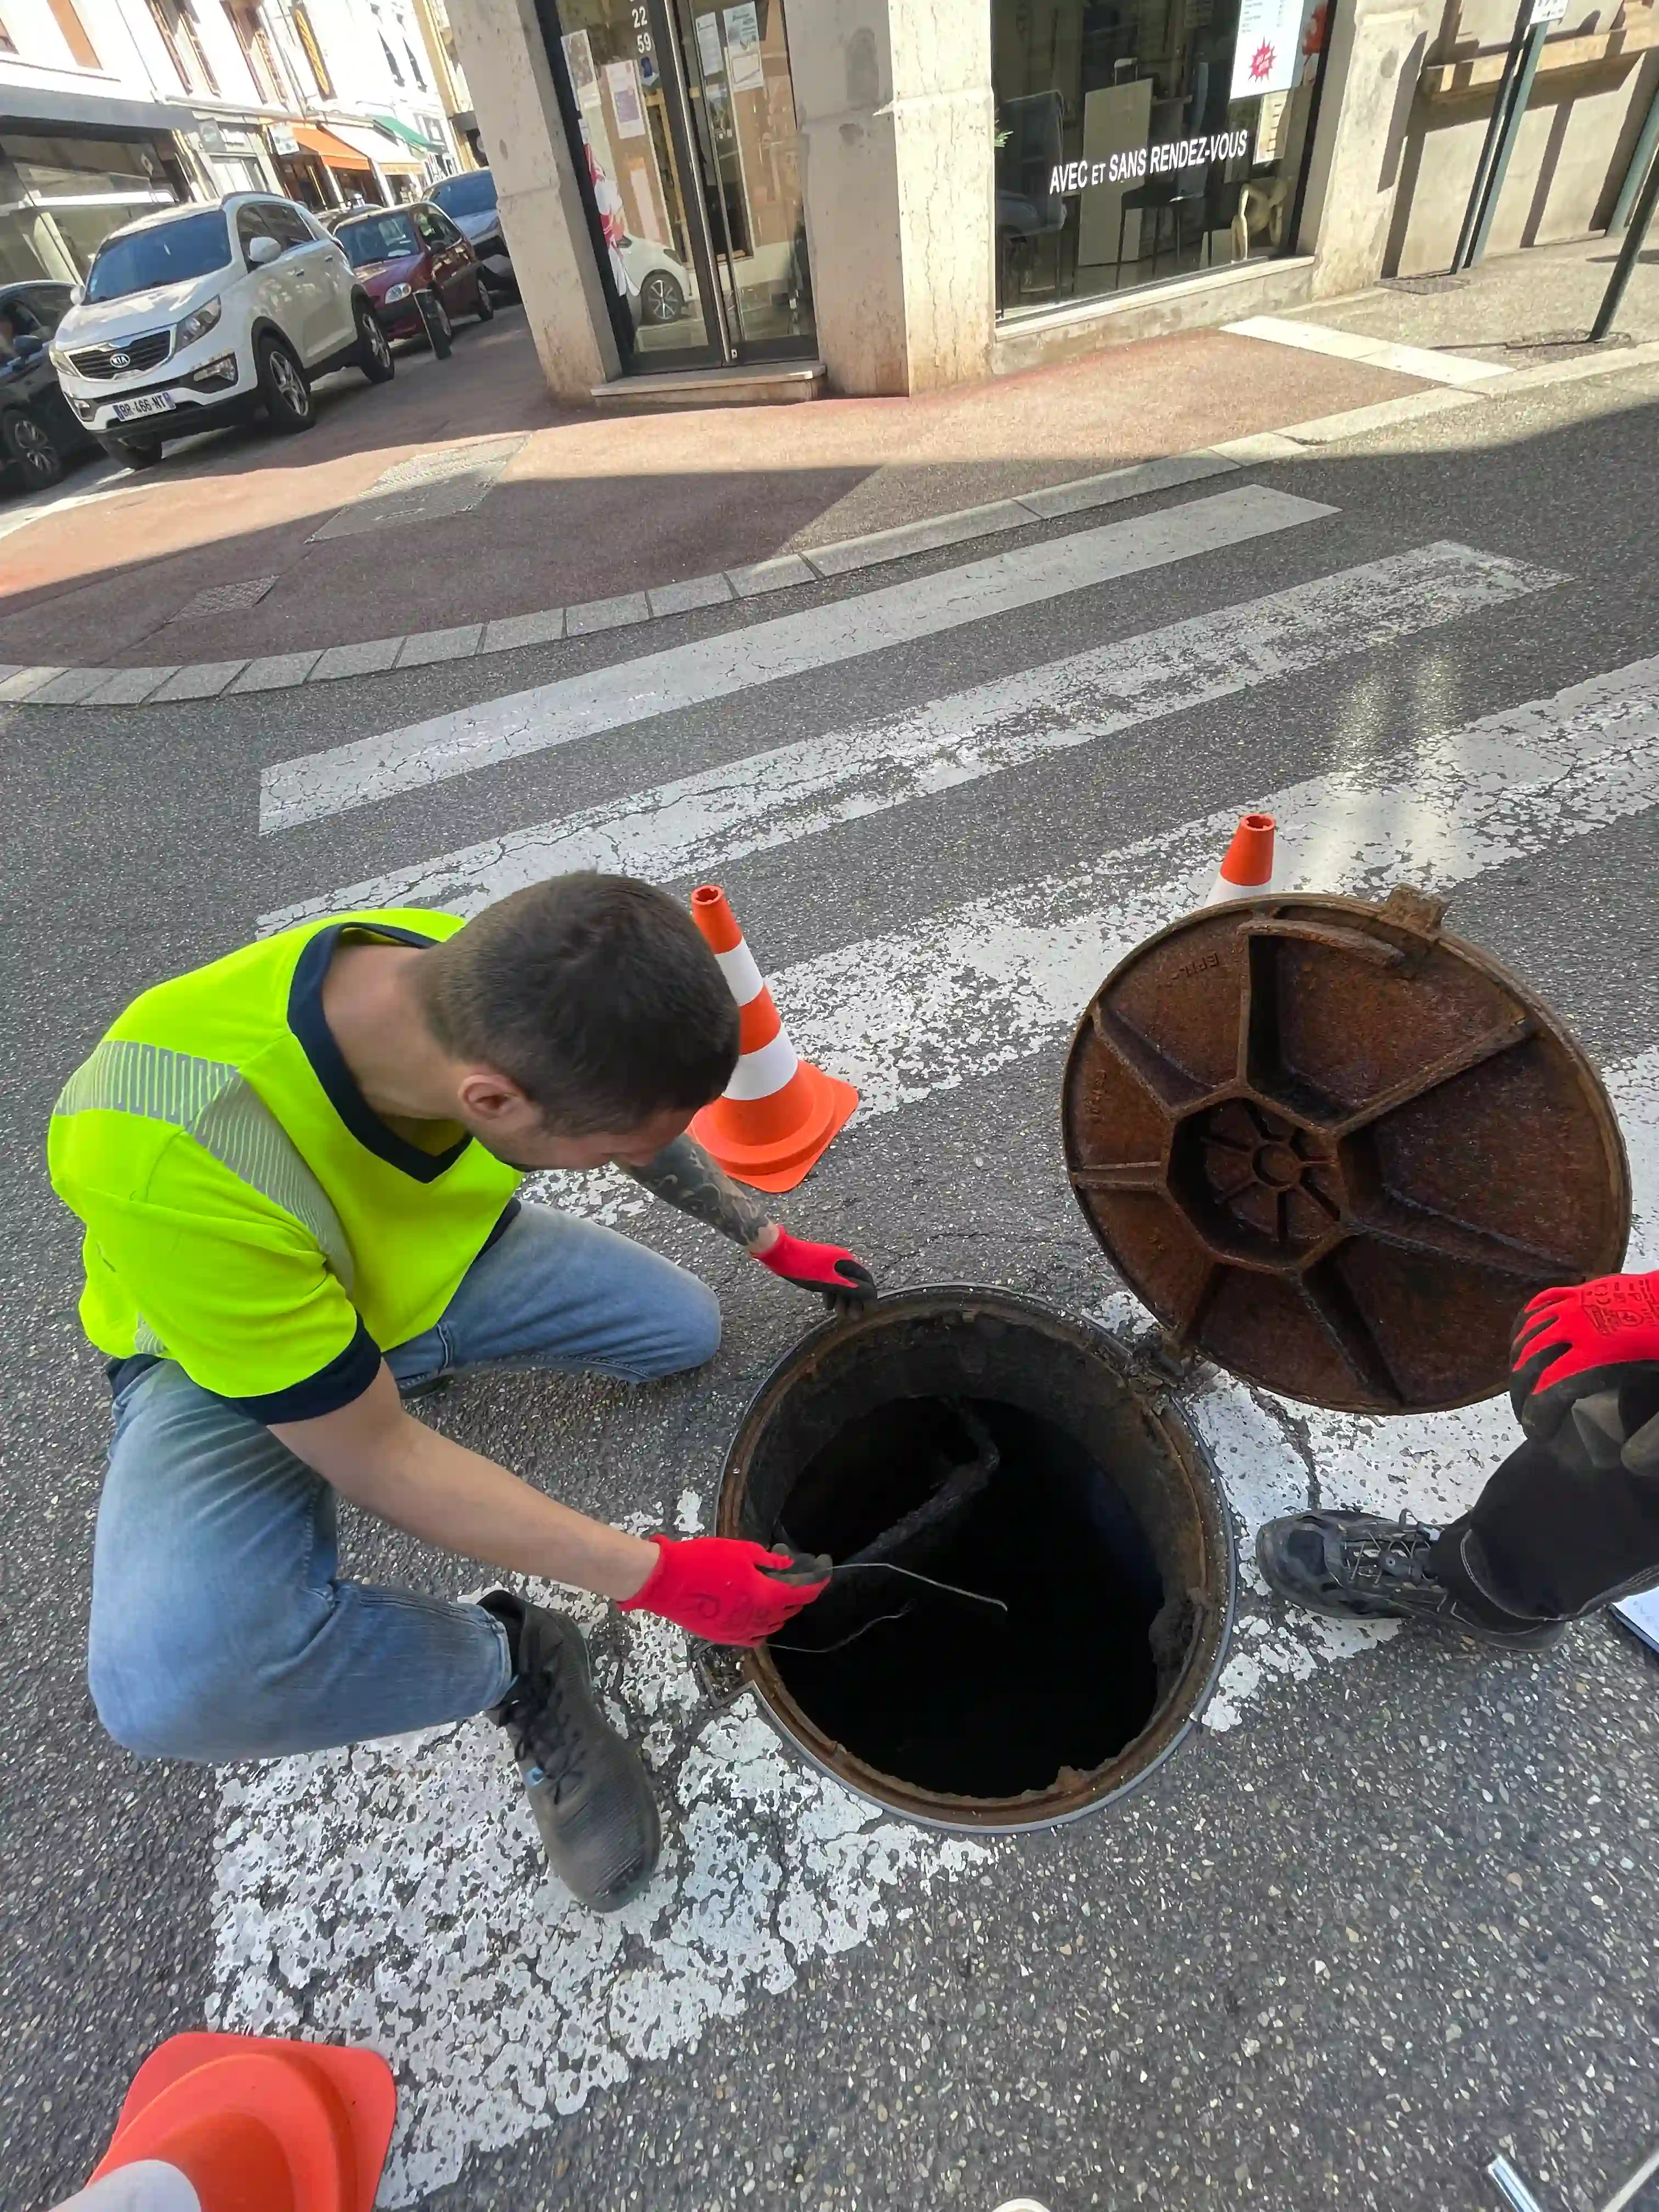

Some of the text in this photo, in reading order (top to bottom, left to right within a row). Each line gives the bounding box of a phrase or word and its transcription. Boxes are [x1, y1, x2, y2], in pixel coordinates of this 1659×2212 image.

[631, 6, 647, 28] 22
[637, 32, 652, 54] 59
[1049, 129, 1248, 195] AVEC ET SANS RENDEZ-VOUS
[111, 356, 128, 365] KIA
